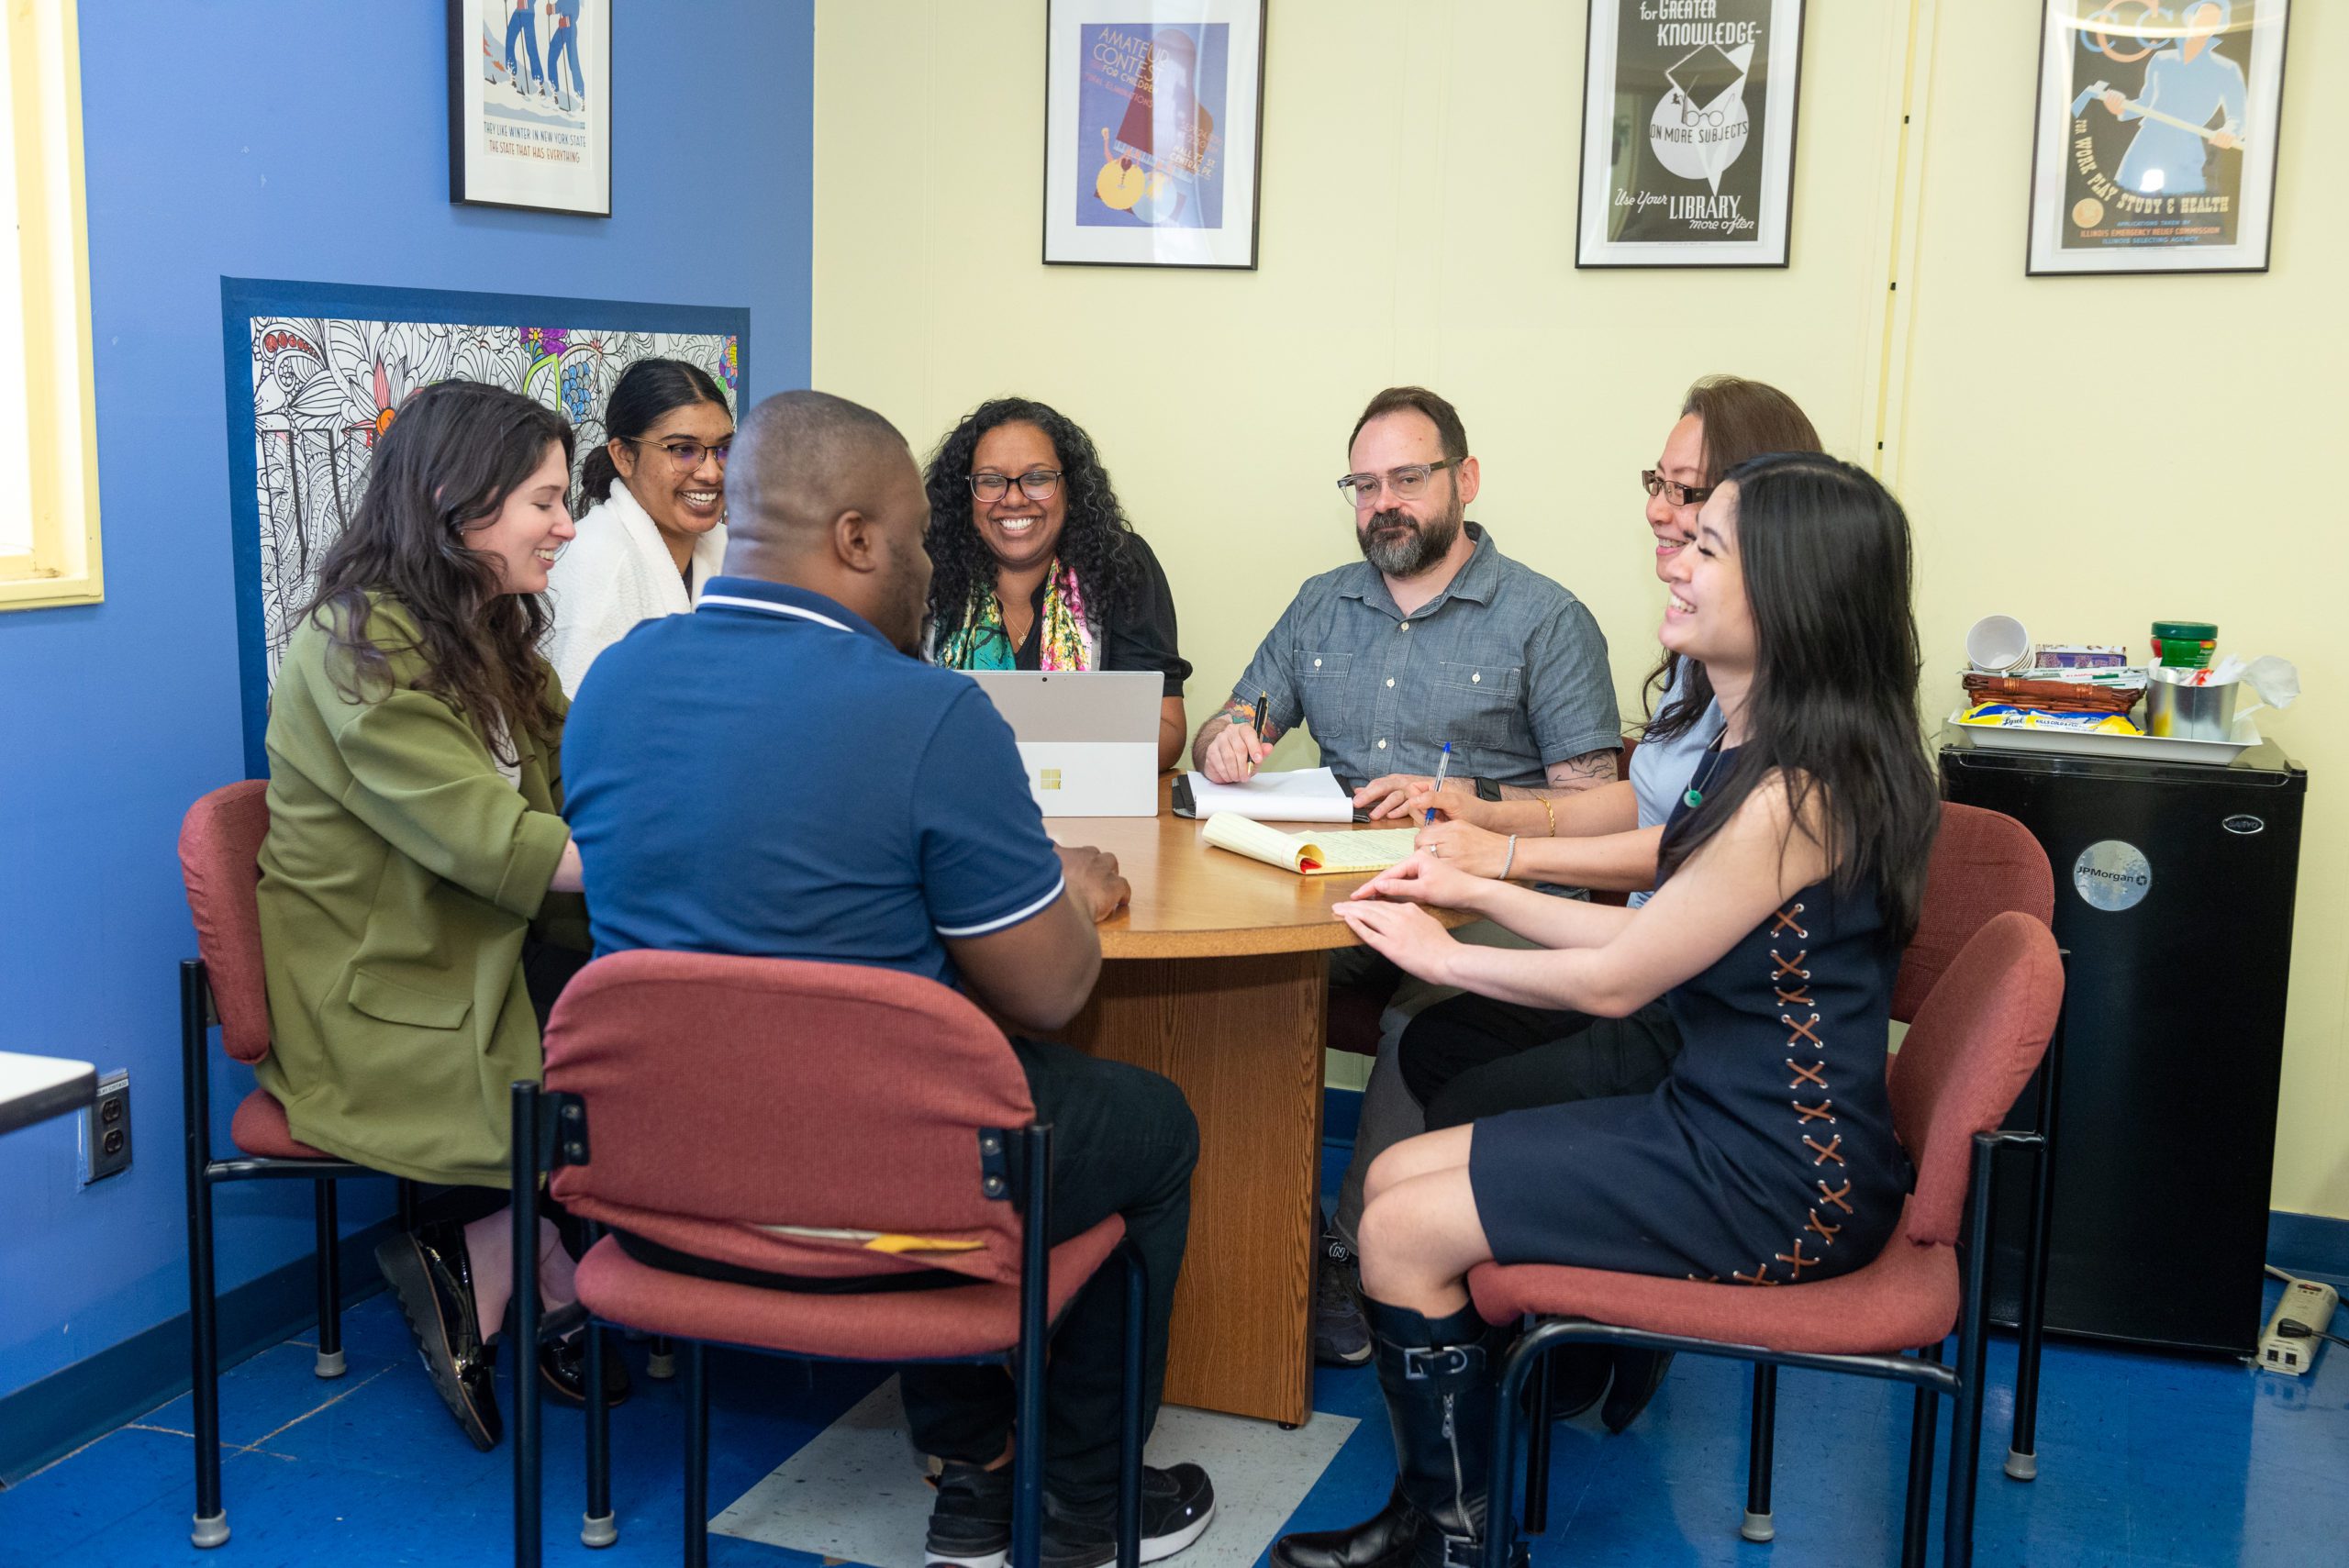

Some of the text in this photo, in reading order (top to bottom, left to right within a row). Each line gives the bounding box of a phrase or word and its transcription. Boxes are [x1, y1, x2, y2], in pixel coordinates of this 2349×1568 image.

[1640, 0, 1717, 20] for GREATER
[1098, 27, 1168, 67] AMATEUR
[1093, 43, 1164, 84] CONTEST
[1103, 64, 1119, 78] FOR
[484, 121, 586, 147] THEY LIKE WINTER IN NEW YORK STATE
[1650, 121, 1748, 144] ON MORE SUBJECTS
[489, 139, 580, 163] THE STATE THAT HAS EVERYTHING
[2075, 136, 2098, 175] WORK
[2087, 172, 2119, 201] PLAY
[2116, 194, 2162, 214] STUDY
[2180, 195, 2230, 214] HEALTH
[1615, 188, 1741, 219] Use Your LIBRARY
[1688, 213, 1754, 235] more often
[2080, 229, 2109, 238] ILLINOIS
[2111, 228, 2151, 237] EMERGENCY
[2152, 228, 2173, 236] RELIEF
[2003, 716, 2024, 726] Lysol
[2076, 866, 2133, 883] JPMorgan
